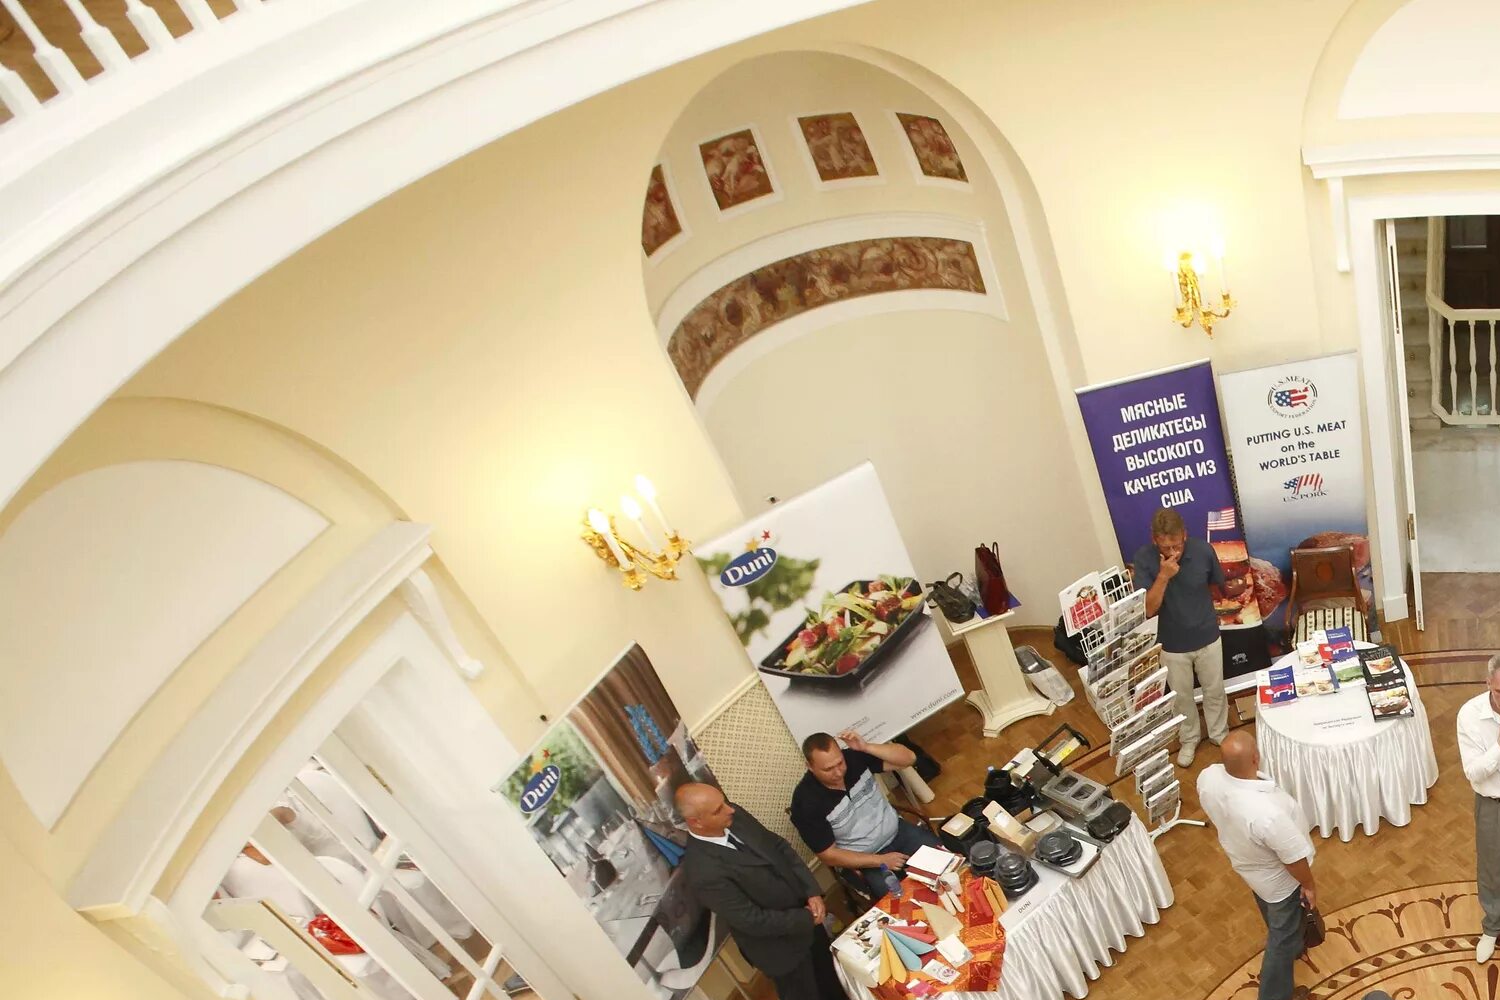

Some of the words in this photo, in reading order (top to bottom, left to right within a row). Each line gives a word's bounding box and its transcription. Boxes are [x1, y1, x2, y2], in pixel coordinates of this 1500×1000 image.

[1121, 393, 1187, 423] МЯСНЫЕ
[1112, 414, 1207, 452] ДЕЛИКАТЕСЫ
[1246, 430, 1291, 445] PUTTING
[1294, 426, 1313, 436] U.S.
[1317, 420, 1346, 432] MEAT
[1281, 444, 1294, 452] on
[1298, 440, 1315, 450] the
[1126, 439, 1204, 471] ВЫСОКОГО
[1259, 455, 1306, 471] WORLD'S
[1310, 450, 1340, 461] TABLE
[1124, 465, 1194, 495] КАЧЕСТВА
[1196, 460, 1216, 476] ИЗ
[1161, 488, 1194, 508] США
[1300, 491, 1327, 499] PORK
[724, 550, 776, 585] Duni
[910, 688, 958, 720] www.duni.com
[522, 768, 560, 811] Duni
